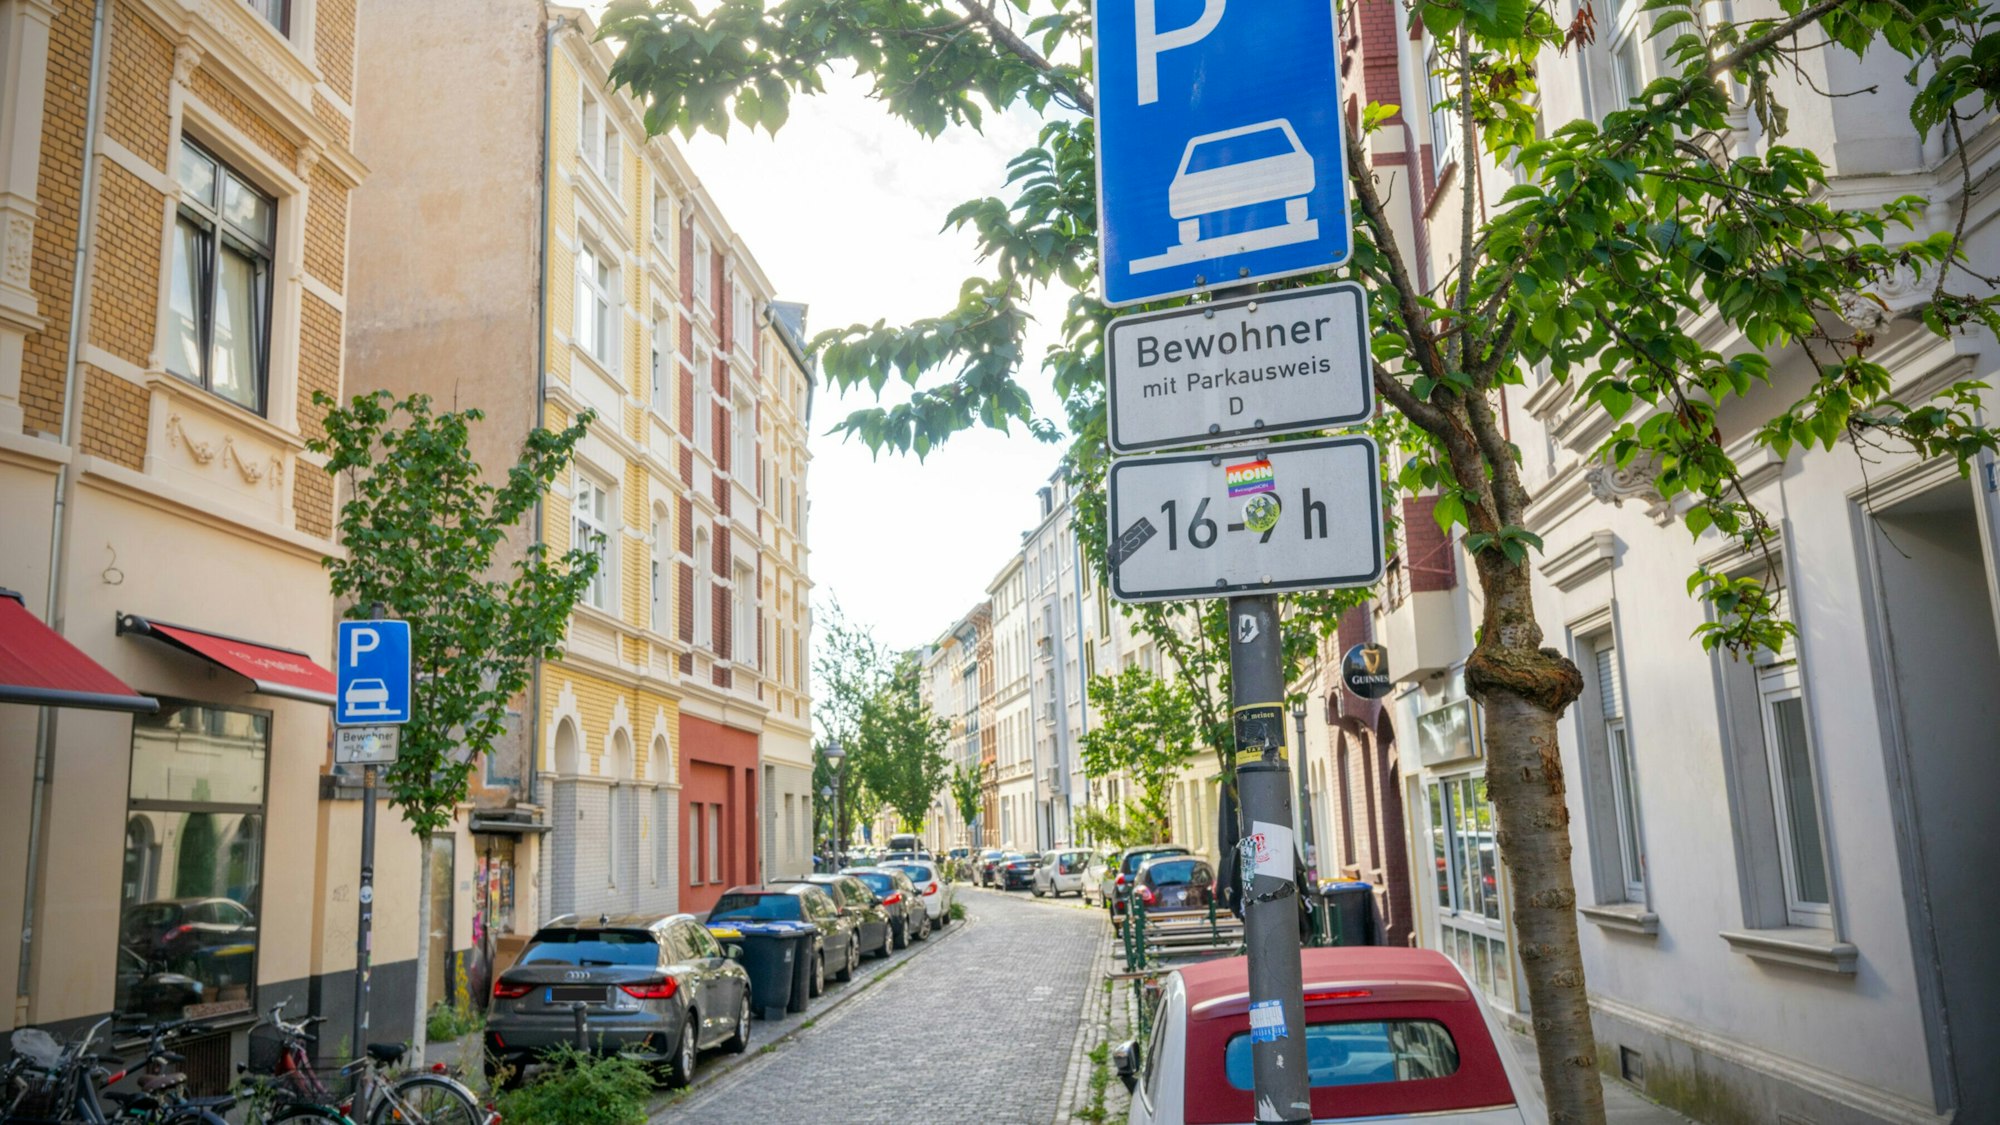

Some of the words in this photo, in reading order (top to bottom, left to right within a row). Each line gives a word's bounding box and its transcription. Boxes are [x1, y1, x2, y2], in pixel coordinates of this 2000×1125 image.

[1134, 0, 1227, 106] P
[1137, 316, 1331, 368] Bewohner
[1143, 377, 1177, 398] mit
[1187, 356, 1331, 392] Parkausweis
[1229, 396, 1244, 416] D
[1228, 466, 1273, 484] MOIN
[1302, 487, 1328, 540] h
[350, 628, 380, 667] P
[1351, 674, 1389, 685] GUINNES
